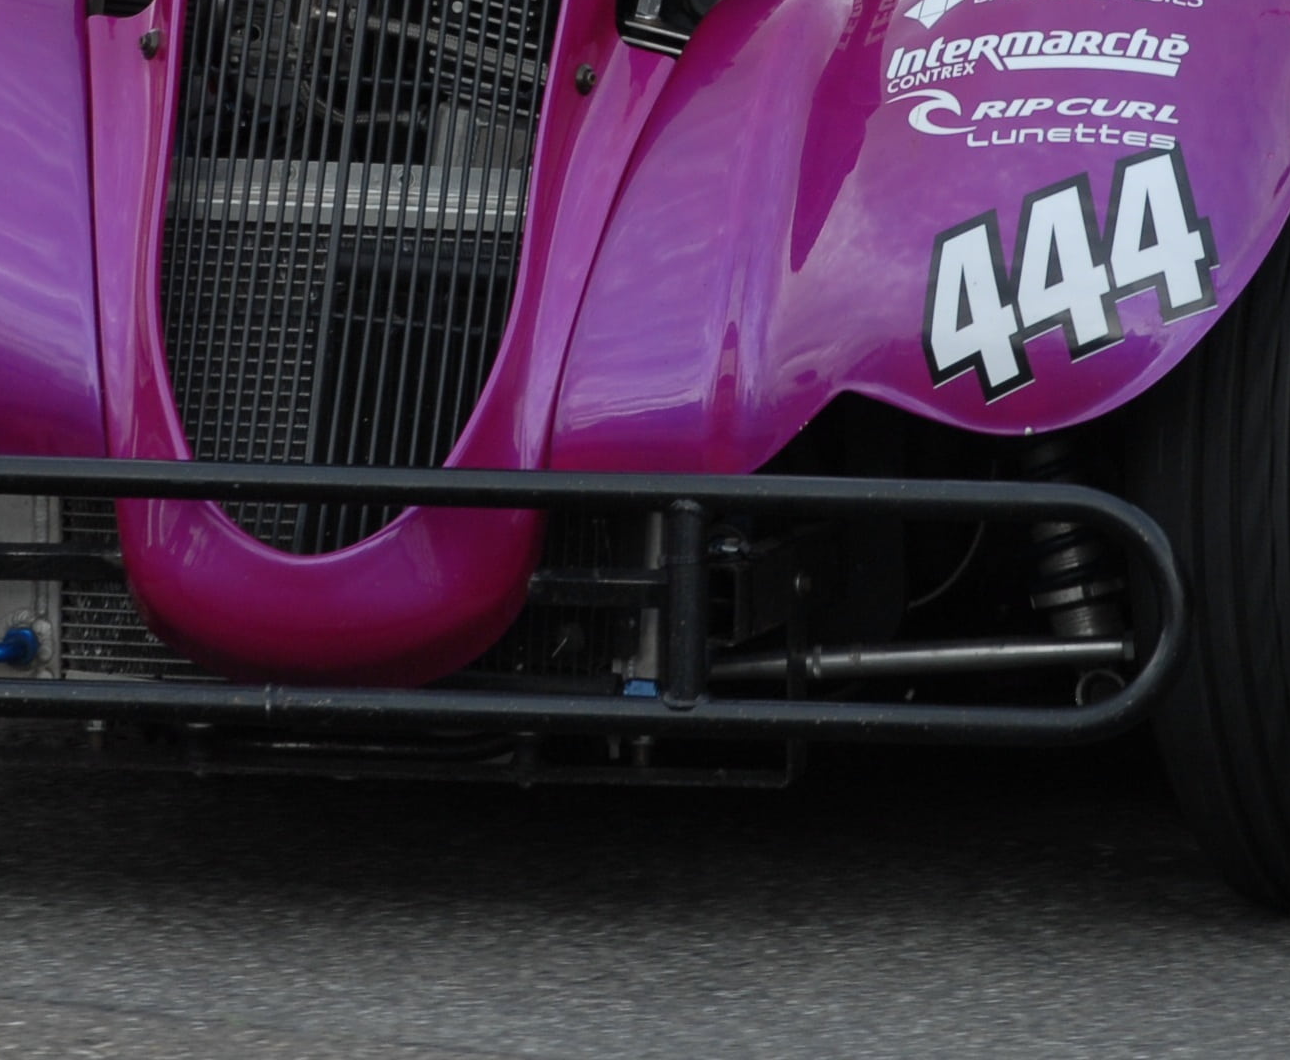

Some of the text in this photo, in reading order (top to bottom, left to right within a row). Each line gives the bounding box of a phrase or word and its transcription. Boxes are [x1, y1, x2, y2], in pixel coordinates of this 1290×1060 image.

[886, 28, 1190, 78] Intermarché
[886, 61, 977, 94] CONTREX
[971, 98, 1180, 124] RIP CURL
[966, 122, 1177, 151] Lunettes
[926, 146, 1213, 396] 444
